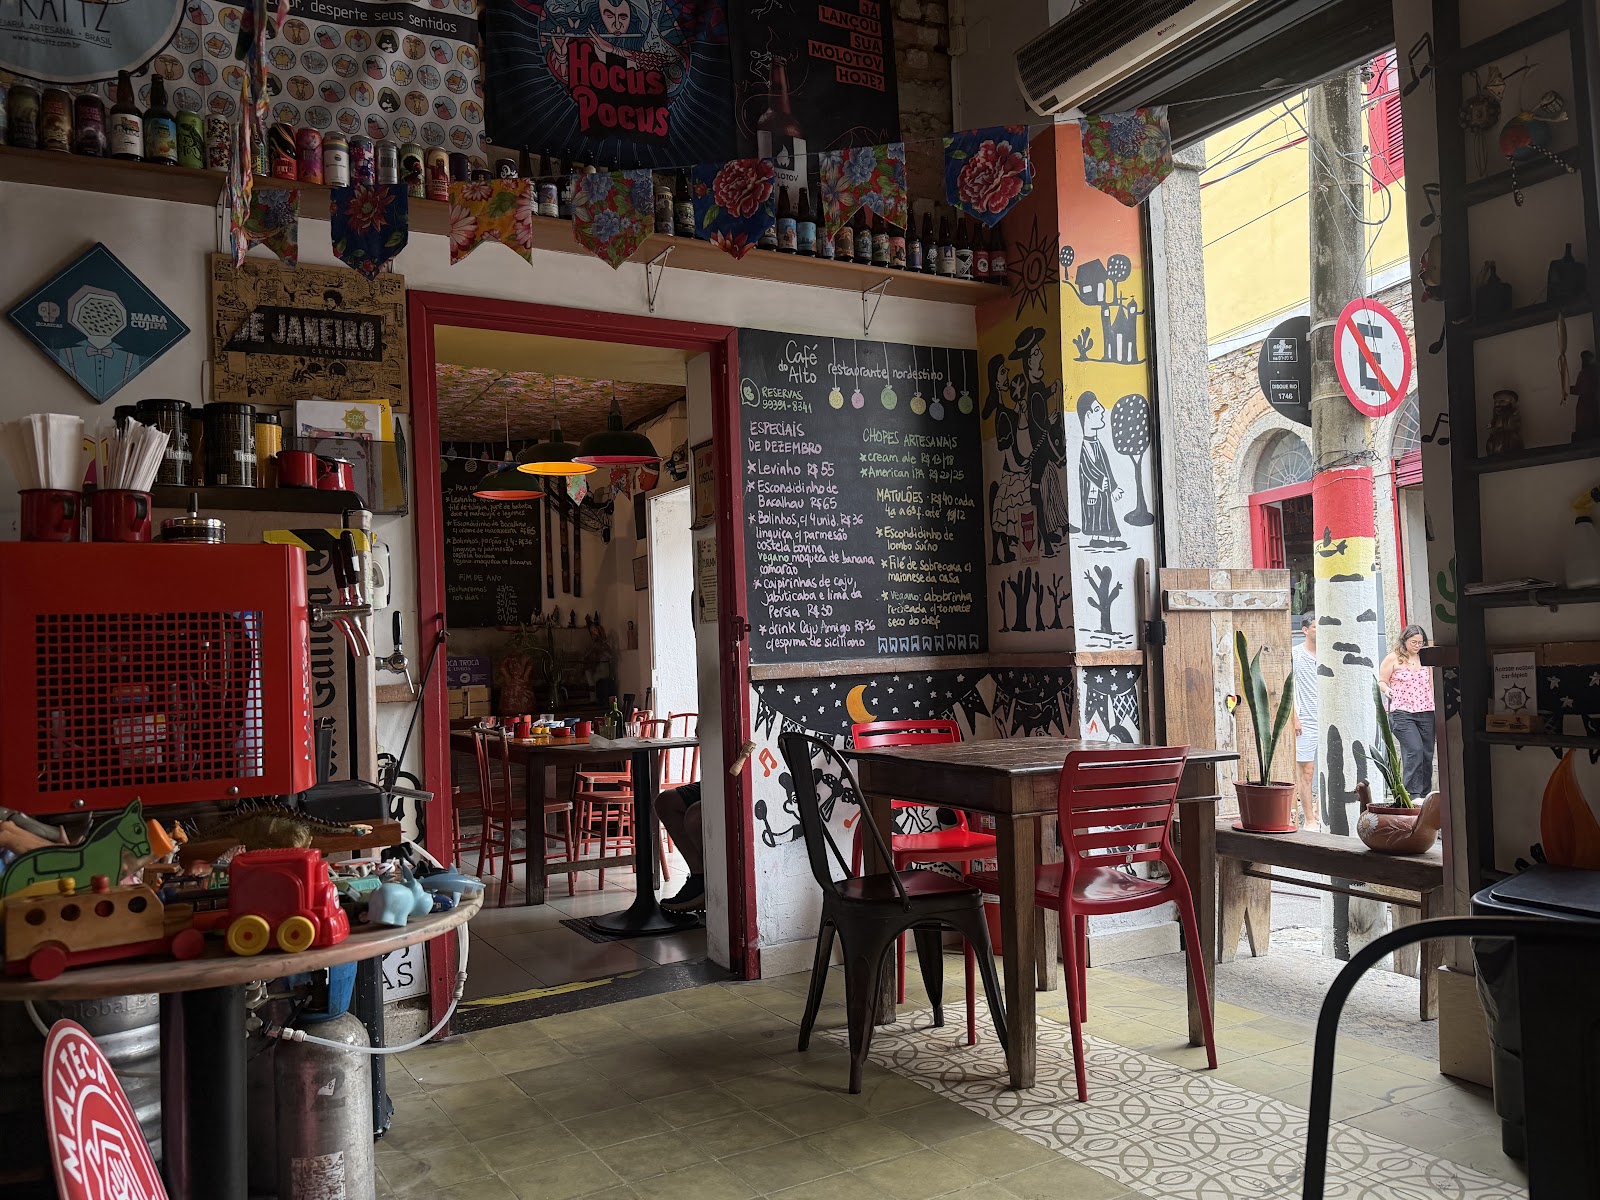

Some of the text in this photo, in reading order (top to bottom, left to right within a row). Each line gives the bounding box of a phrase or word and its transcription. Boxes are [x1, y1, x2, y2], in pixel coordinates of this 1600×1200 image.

[310, 0, 369, 22] desperte
[374, 9, 404, 21] seus
[408, 13, 457, 34] sentidos
[821, 6, 880, 34] LANÇOU
[29, 23, 112, 46] ARTESANAL BRASIL
[854, 35, 882, 54] SUA
[811, 42, 882, 70] MOLOTOV
[839, 69, 883, 89] HOJE?
[131, 312, 169, 324] MARA
[271, 314, 376, 351] JANEIRO
[312, 348, 375, 369] CERVEJARIA
[786, 340, 818, 368] Café
[778, 359, 788, 371] do
[828, 360, 943, 381] restaurante nordestino
[789, 365, 817, 384] Alto
[762, 386, 804, 401] RESERVAS
[863, 428, 899, 445] CHOPES
[748, 438, 823, 455] DE DEZEMBRO
[868, 453, 899, 463] cream
[902, 452, 917, 464] ale
[758, 459, 802, 475] Levinho
[869, 466, 910, 478] American
[757, 480, 839, 494] Escondidinho de
[758, 494, 804, 509] Bacalhau
[955, 494, 976, 507] cada
[809, 512, 816, 527] 4
[756, 527, 793, 543] linguiça
[804, 527, 849, 544] parmesão
[884, 526, 956, 541] Escondidinho de
[756, 540, 826, 554] costela bovina
[888, 539, 914, 551] lombo
[792, 554, 828, 569] moqueca
[829, 550, 840, 564] de
[841, 549, 876, 566] banana
[889, 555, 906, 570] Filé
[907, 555, 918, 571] de
[459, 574, 471, 582] FIM
[486, 574, 503, 582] ANO
[763, 576, 818, 594] caipirinhas
[819, 574, 831, 588] de
[888, 570, 926, 584] maionese
[925, 570, 937, 583] da
[761, 588, 863, 606] jabuticaba e lima da
[923, 587, 973, 603] abobrinha
[938, 602, 972, 613] tomate
[888, 614, 941, 630] seco do chef
[800, 620, 819, 641] Caju
[820, 620, 851, 639] Amigo
[308, 584, 337, 710] Galica
[809, 636, 823, 649] de
[459, 659, 480, 667] TROCA
[56, 1041, 112, 1185] MALTECA
